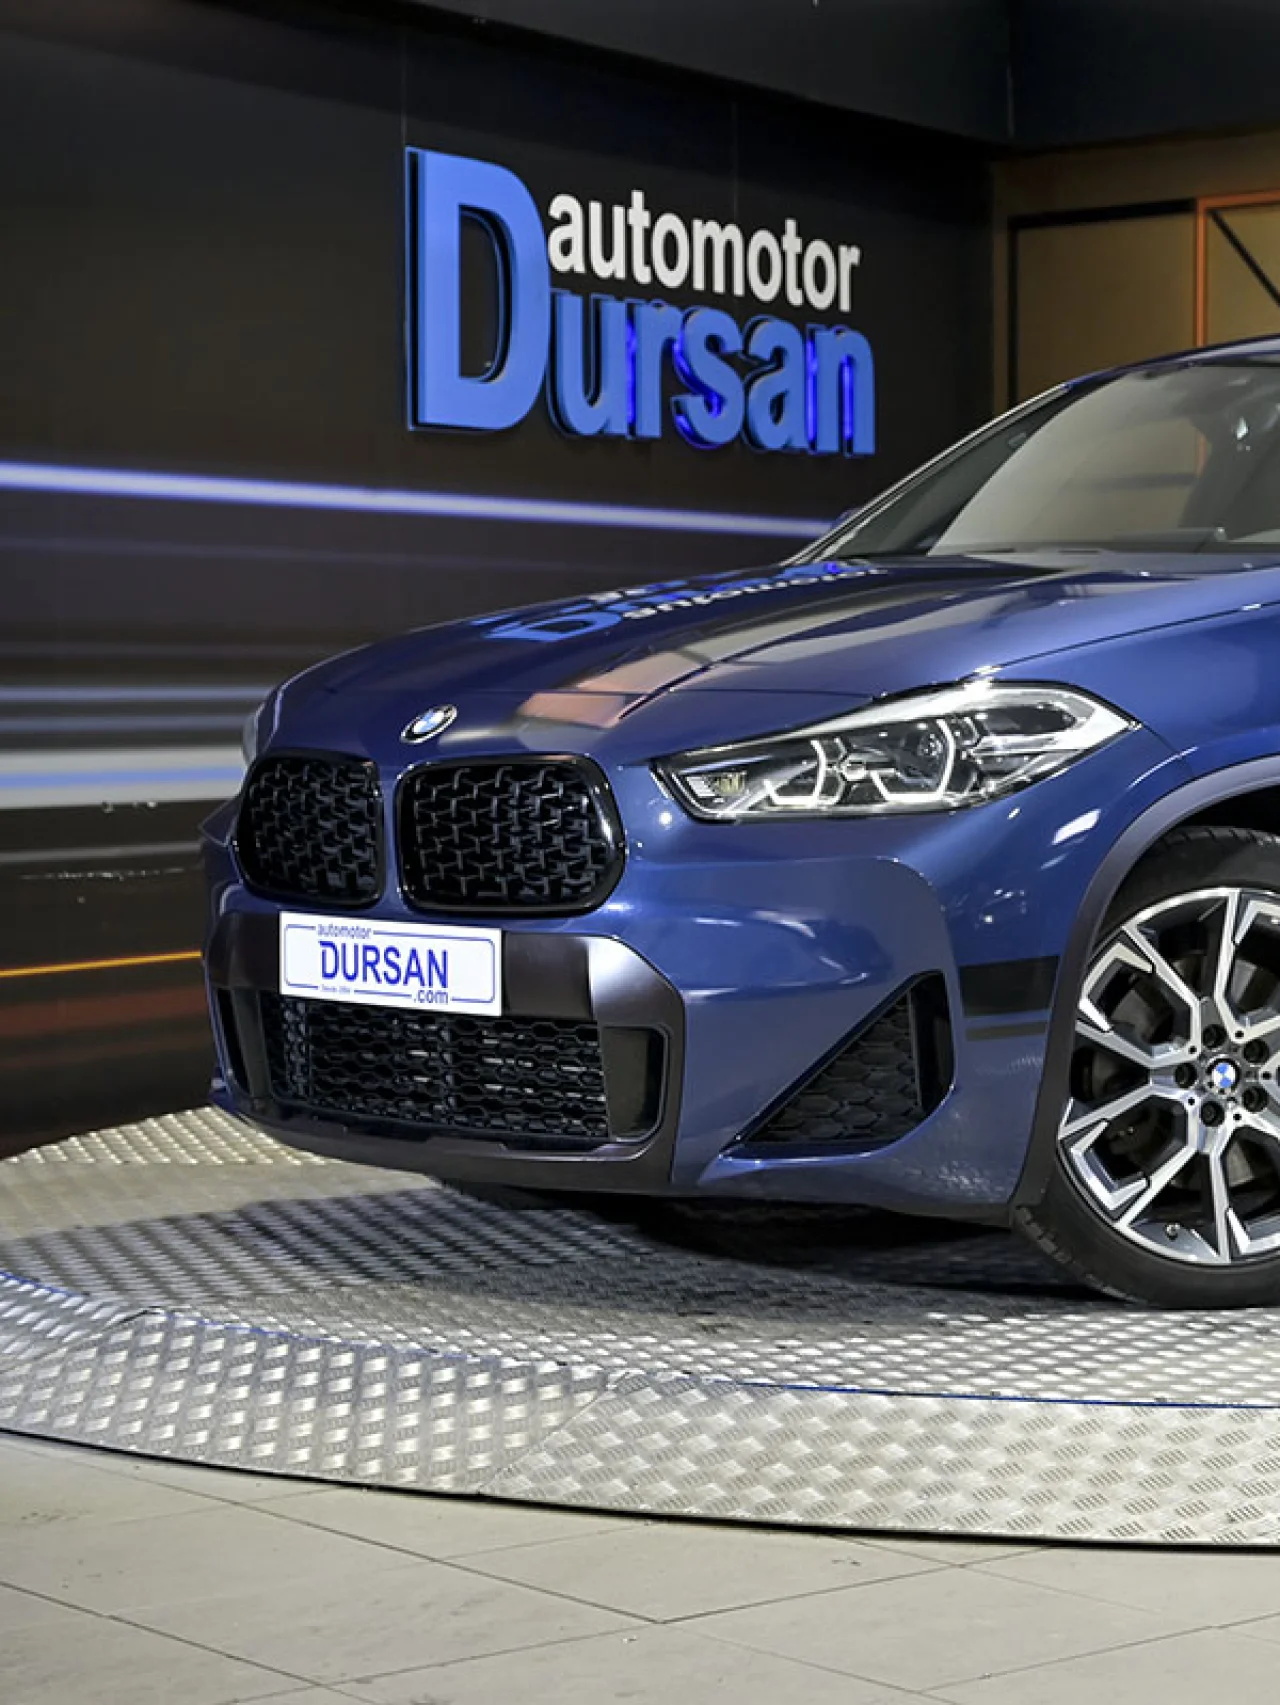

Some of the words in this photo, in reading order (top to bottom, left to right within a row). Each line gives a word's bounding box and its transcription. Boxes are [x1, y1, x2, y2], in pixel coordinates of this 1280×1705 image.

[547, 189, 861, 312] automotor
[404, 146, 876, 457] Dursan
[317, 923, 372, 939] automotor
[318, 940, 449, 989] DURSAN
[413, 989, 449, 1006] .com
